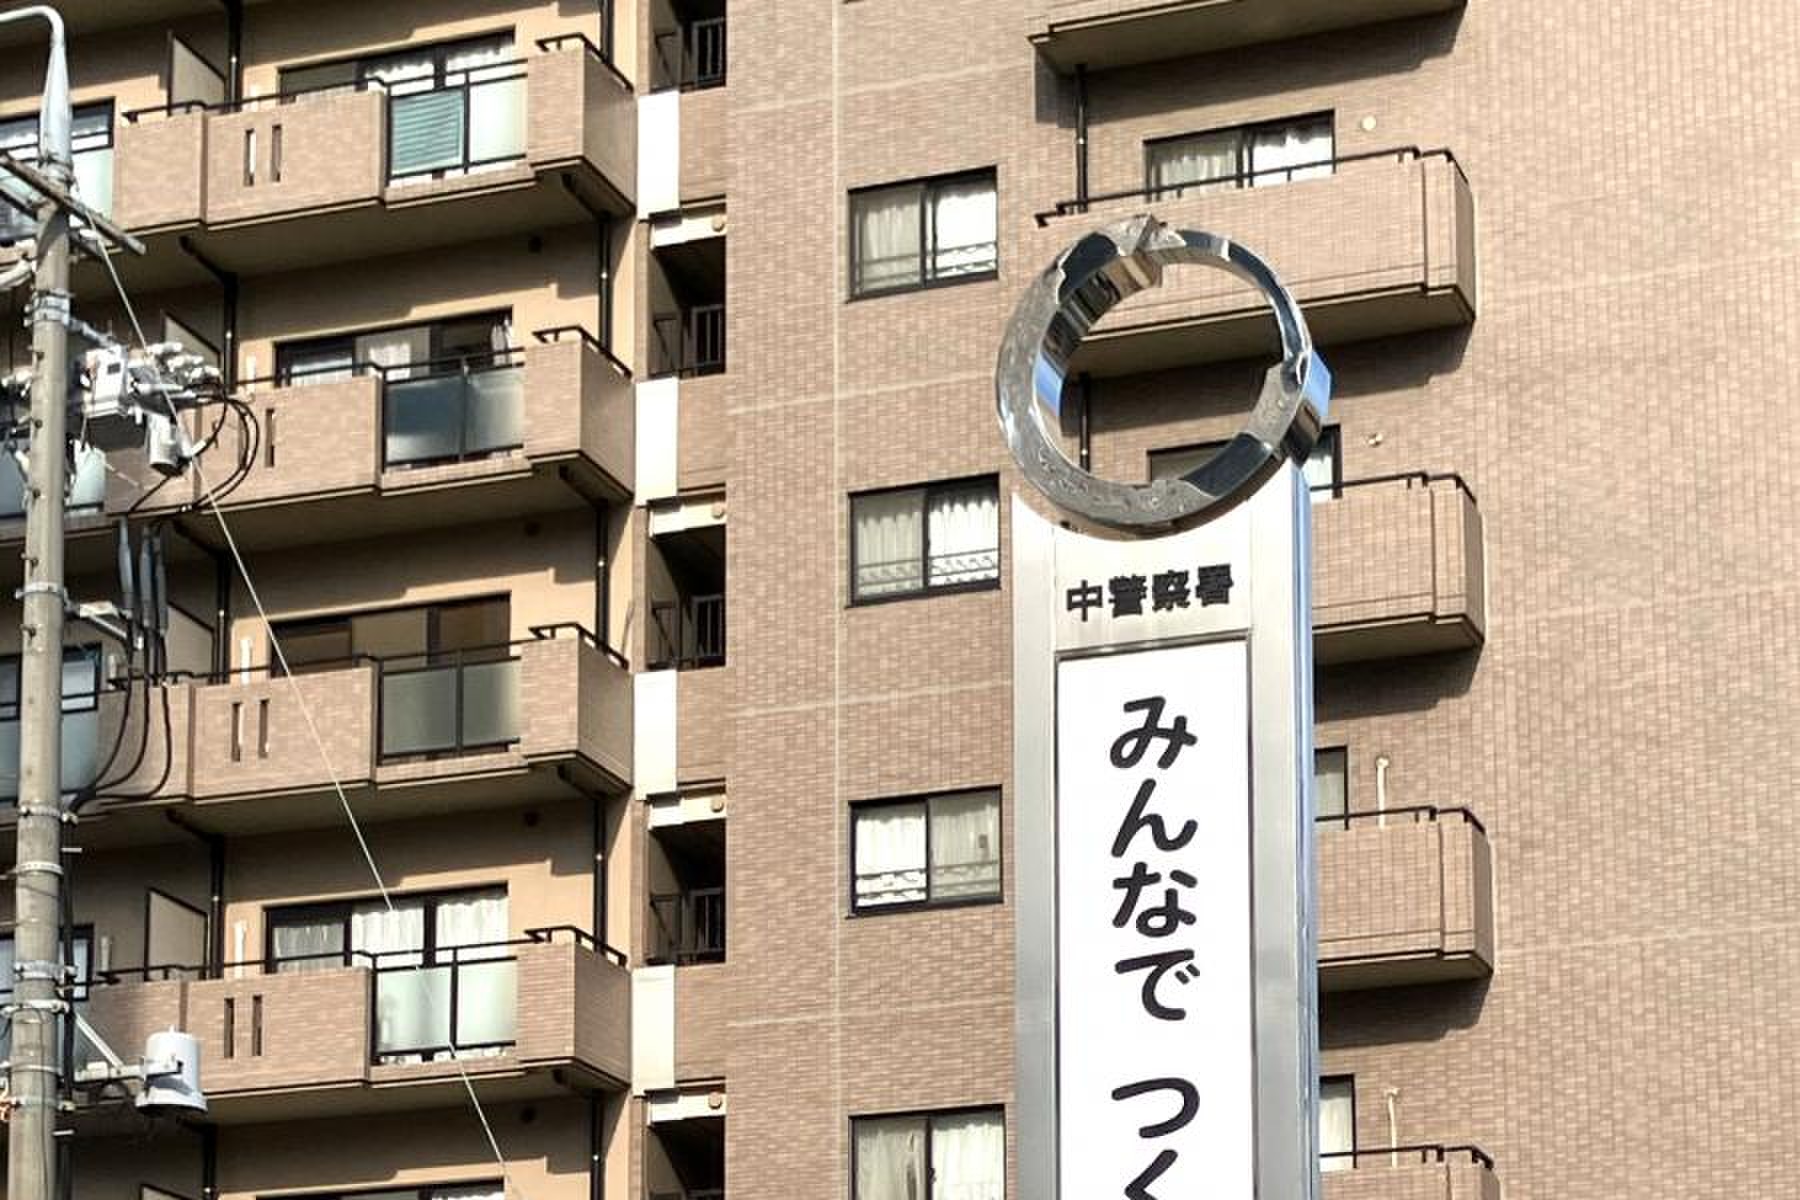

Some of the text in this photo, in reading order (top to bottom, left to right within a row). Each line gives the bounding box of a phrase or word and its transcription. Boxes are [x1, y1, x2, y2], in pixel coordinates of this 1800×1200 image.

[1066, 563, 1234, 622] 中警察署
[1109, 696, 1201, 1021] みんなで
